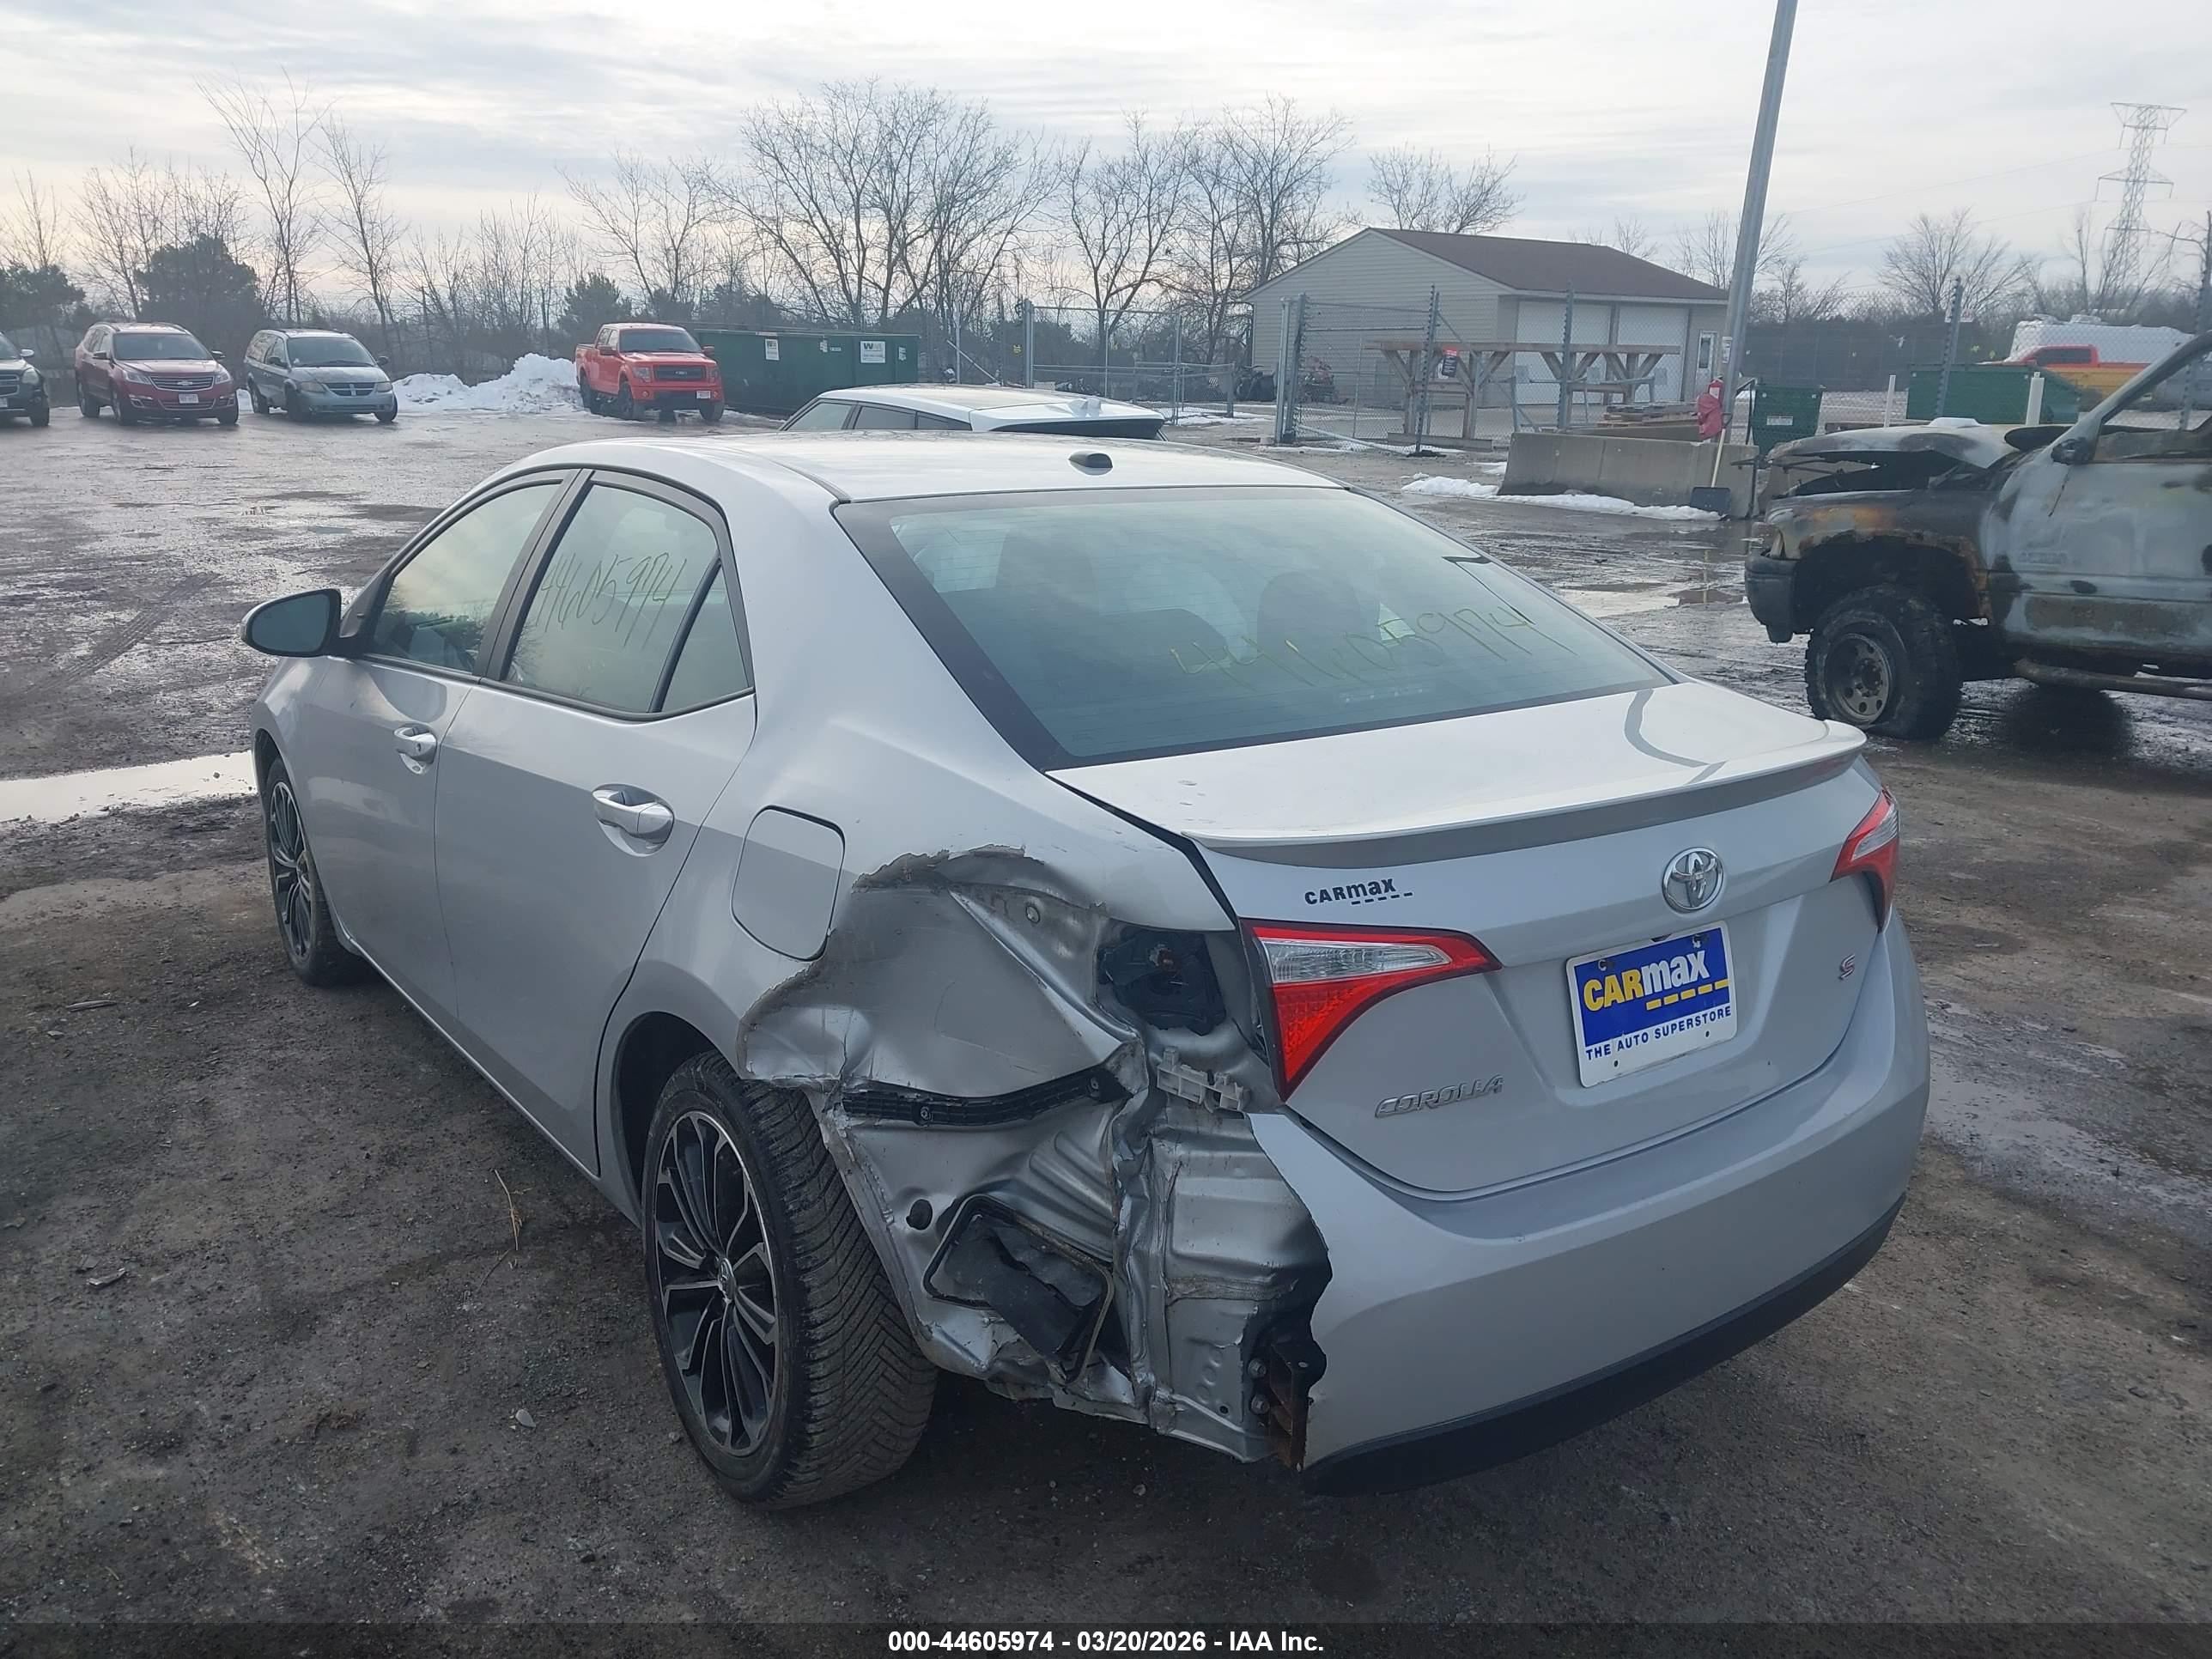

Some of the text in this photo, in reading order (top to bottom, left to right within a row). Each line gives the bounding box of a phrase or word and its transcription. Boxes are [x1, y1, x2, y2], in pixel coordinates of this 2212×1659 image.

[1586, 1006, 1732, 1060] THE AUTO SUPERSTORE
[1374, 1073, 1504, 1118] COROLLA
